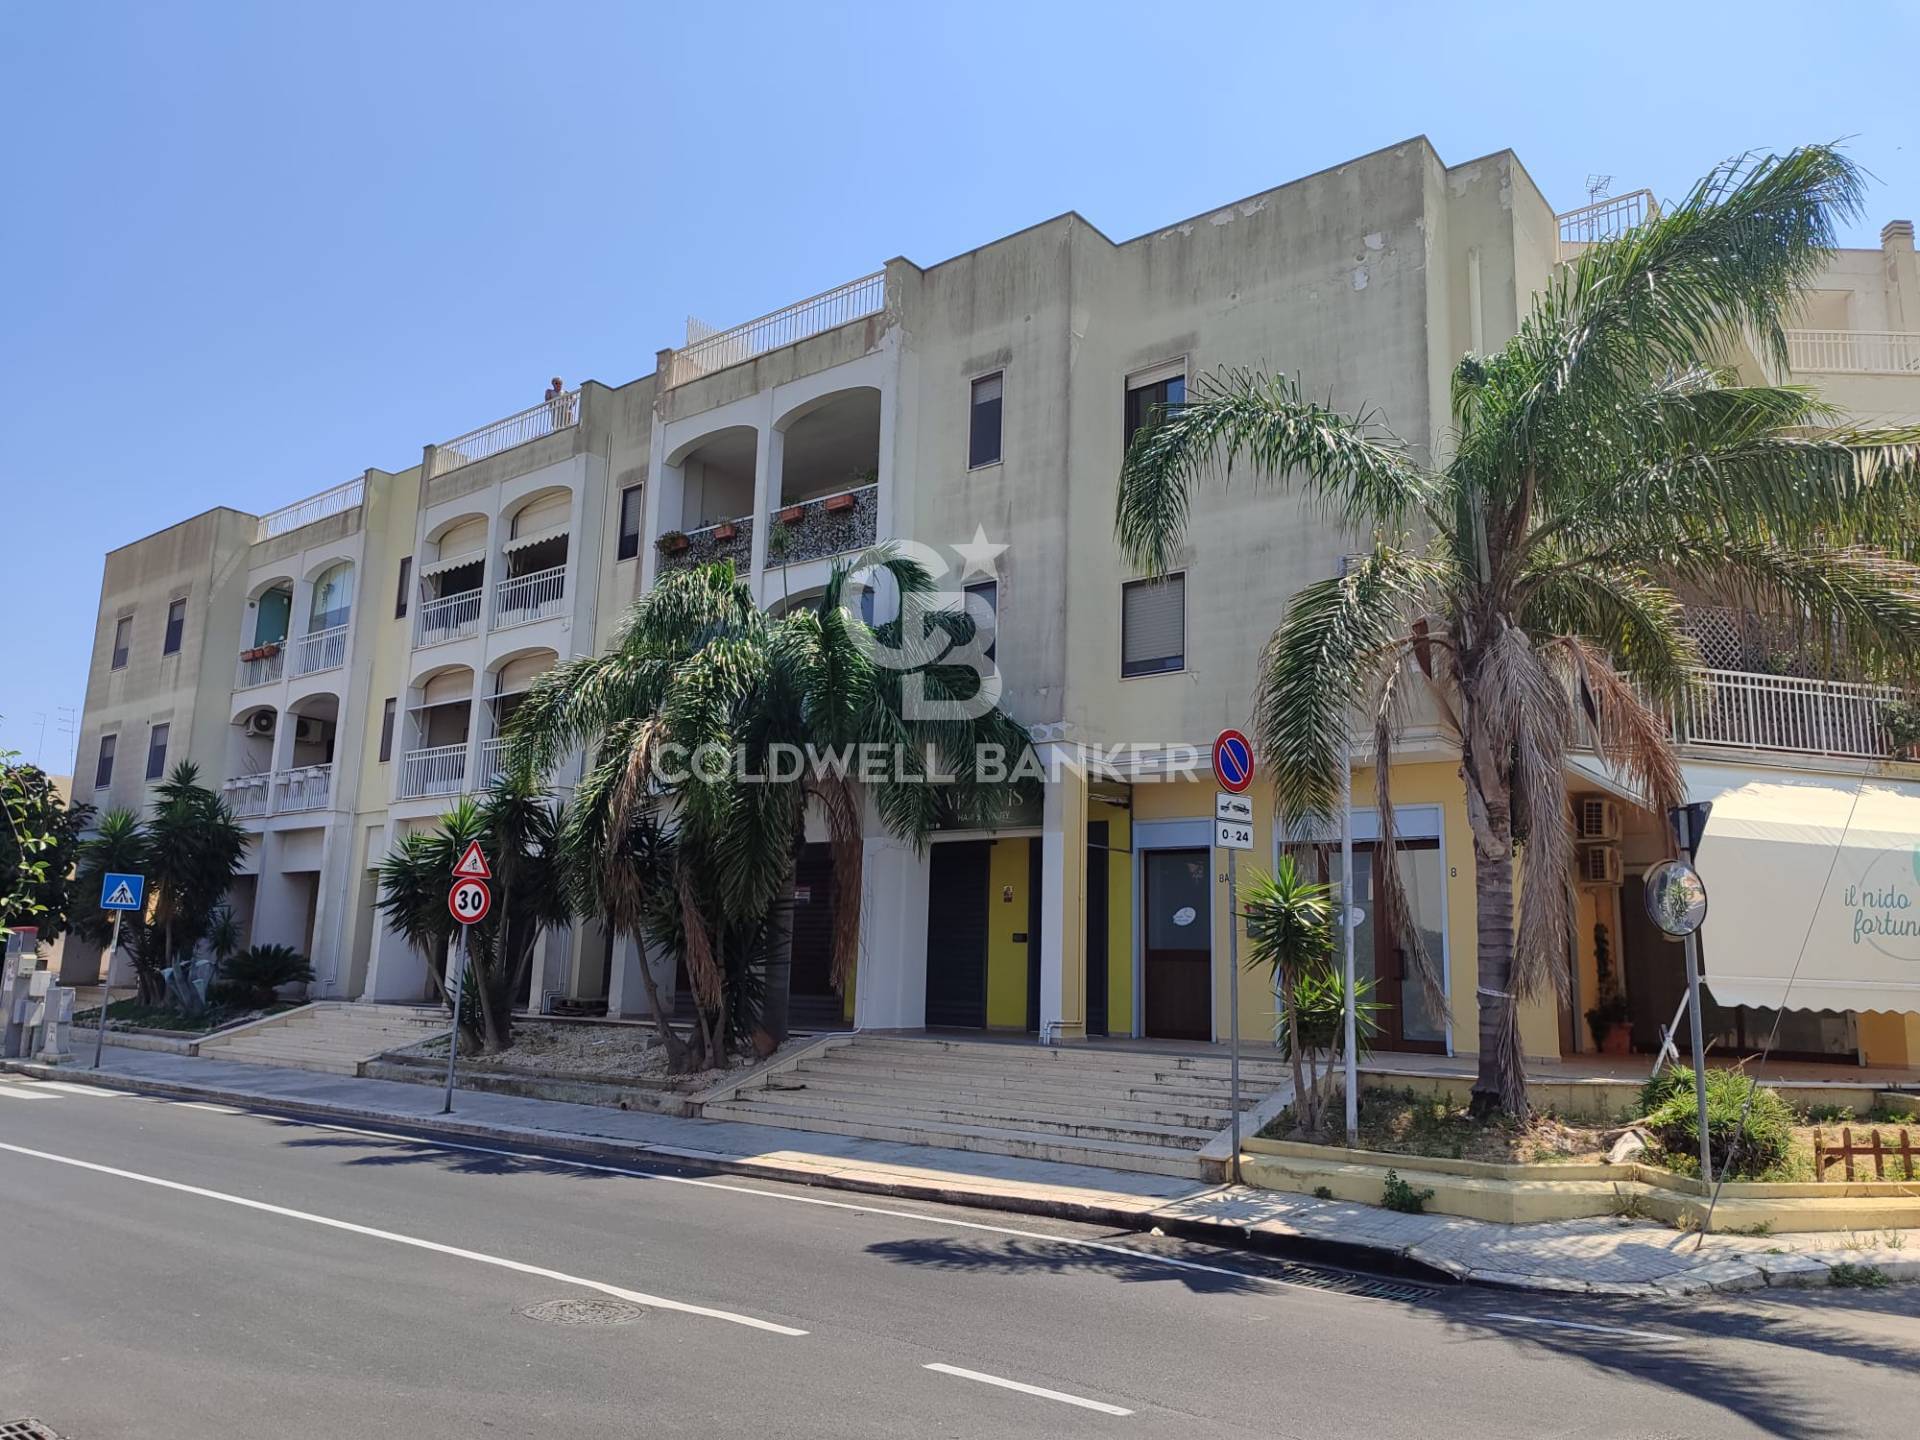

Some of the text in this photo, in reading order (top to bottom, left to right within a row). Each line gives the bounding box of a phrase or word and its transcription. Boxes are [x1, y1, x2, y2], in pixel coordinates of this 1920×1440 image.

[1450, 867, 1457, 877] 8
[458, 890, 482, 911] 30
[1844, 884, 1912, 909] il nido
[1853, 908, 1920, 945] fortun
